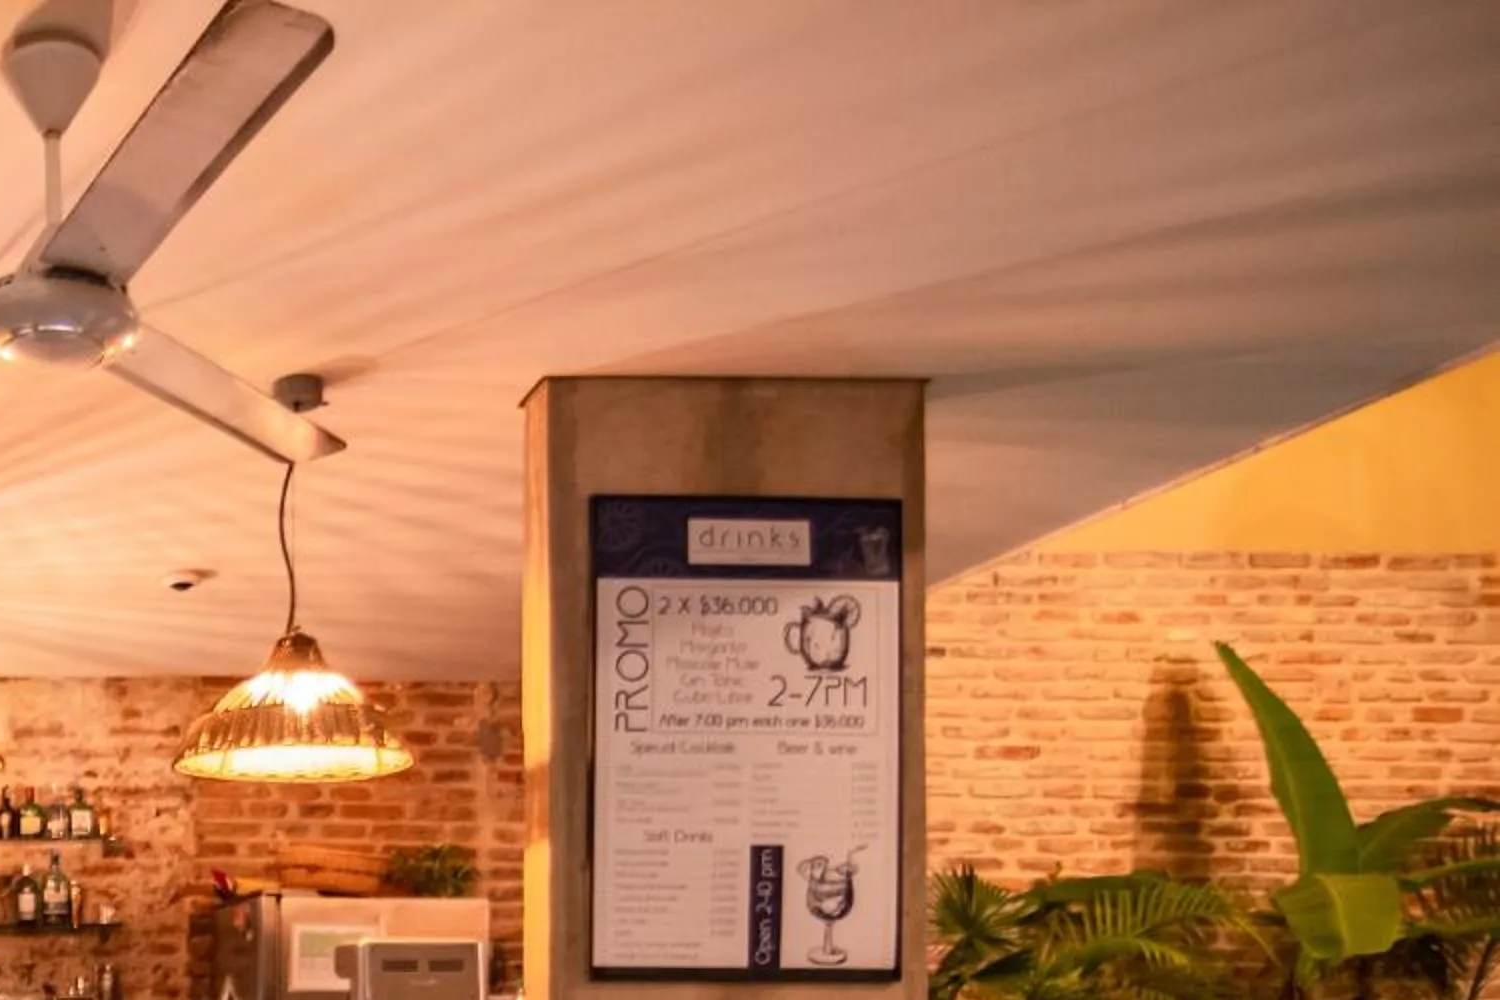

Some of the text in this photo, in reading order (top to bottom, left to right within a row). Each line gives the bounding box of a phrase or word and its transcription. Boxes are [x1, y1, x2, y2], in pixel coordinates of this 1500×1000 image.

[698, 523, 800, 549] drinks
[657, 596, 672, 616] 2
[614, 586, 650, 733] PROMO
[658, 713, 689, 729] After
[754, 918, 776, 965] Open
